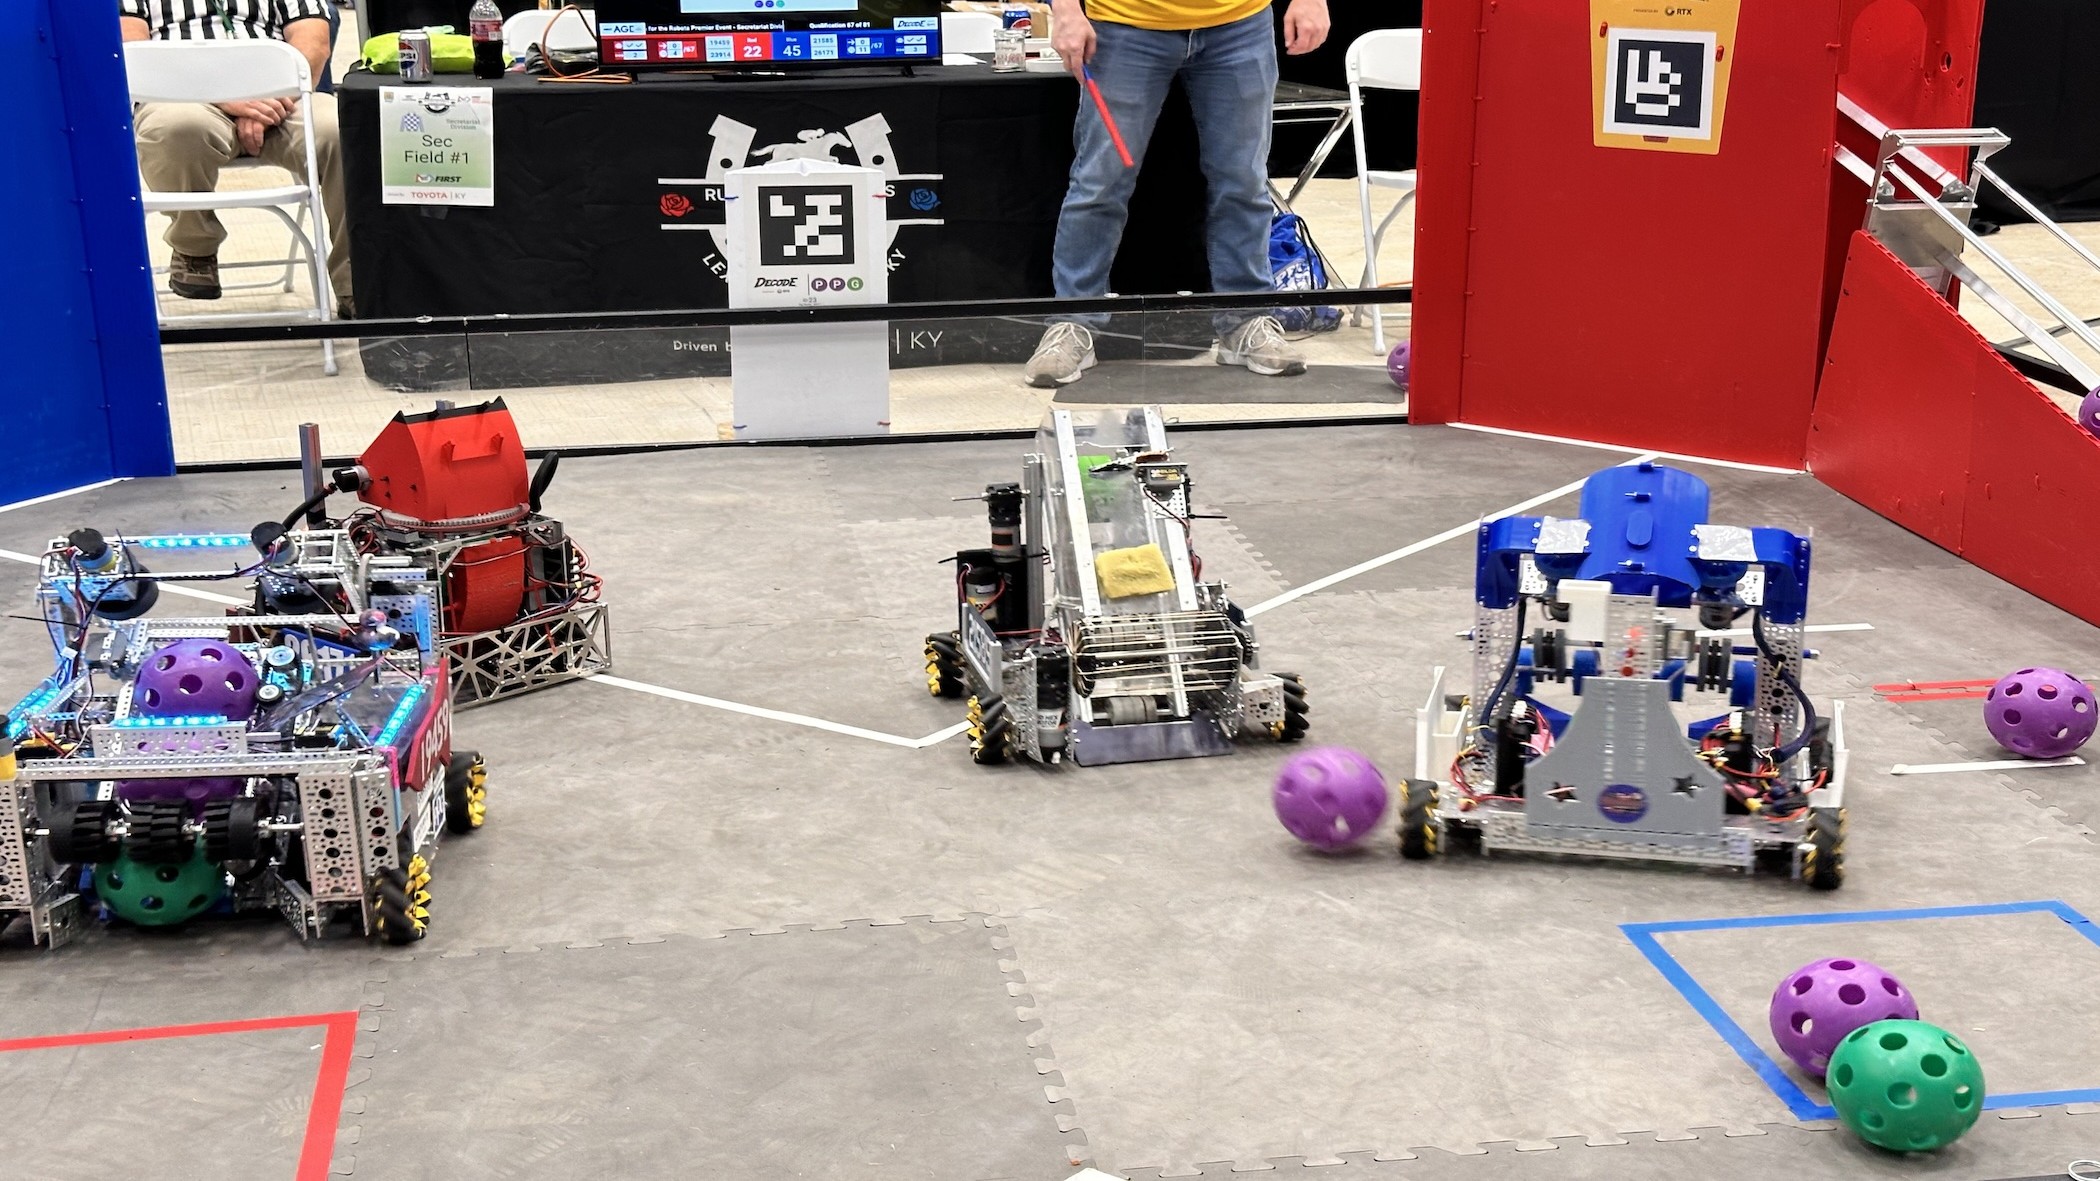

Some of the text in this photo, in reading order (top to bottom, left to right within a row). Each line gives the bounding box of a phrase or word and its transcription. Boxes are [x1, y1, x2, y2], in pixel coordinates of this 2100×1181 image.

[744, 46, 762, 57] 22
[783, 45, 801, 56] 45
[422, 134, 453, 147] Sec
[405, 150, 468, 164] Field #1
[754, 277, 798, 288] DECODE
[673, 340, 718, 351] Driven
[911, 331, 943, 349] KY
[421, 698, 449, 782] 19459
